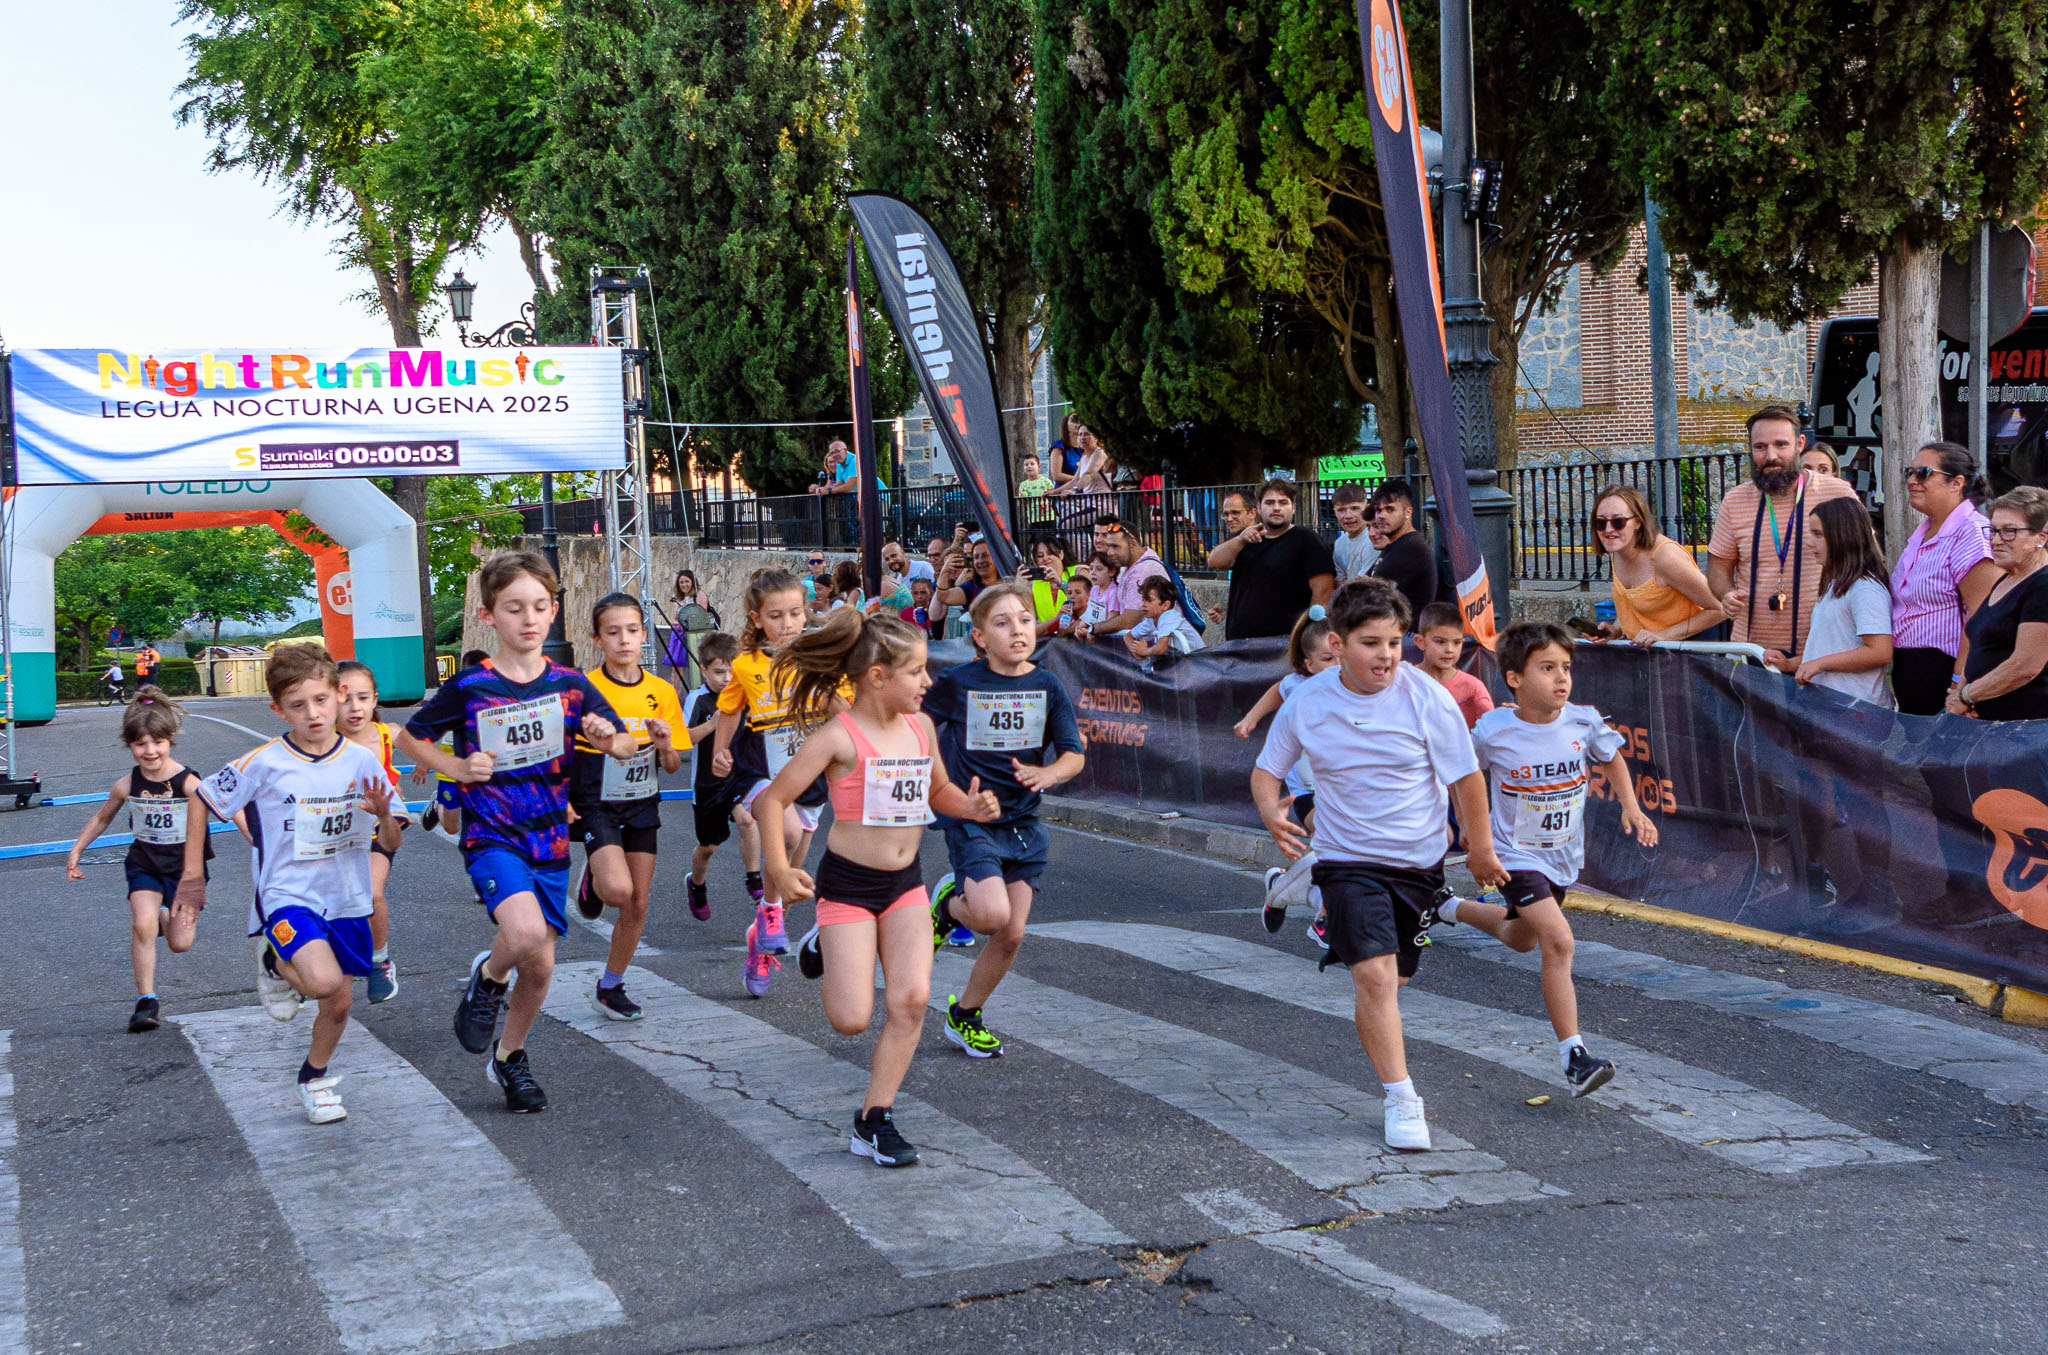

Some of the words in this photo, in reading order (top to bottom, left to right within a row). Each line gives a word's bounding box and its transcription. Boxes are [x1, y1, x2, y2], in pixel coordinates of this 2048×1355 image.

[102, 400, 202, 419] LEGUA
[213, 398, 384, 418] NOCTURNA
[394, 396, 495, 414] UGENA
[503, 395, 569, 413] 2025
[261, 448, 334, 462] sumialki
[335, 445, 454, 465] 00:00:03
[1079, 687, 1142, 714] EVENTOS
[989, 711, 1025, 730] 435
[506, 720, 545, 745] 438
[625, 765, 650, 784] 427
[1510, 759, 1580, 779] e3TEAM
[144, 813, 173, 829] 428
[321, 811, 353, 836] 433
[1541, 810, 1570, 831] 431
